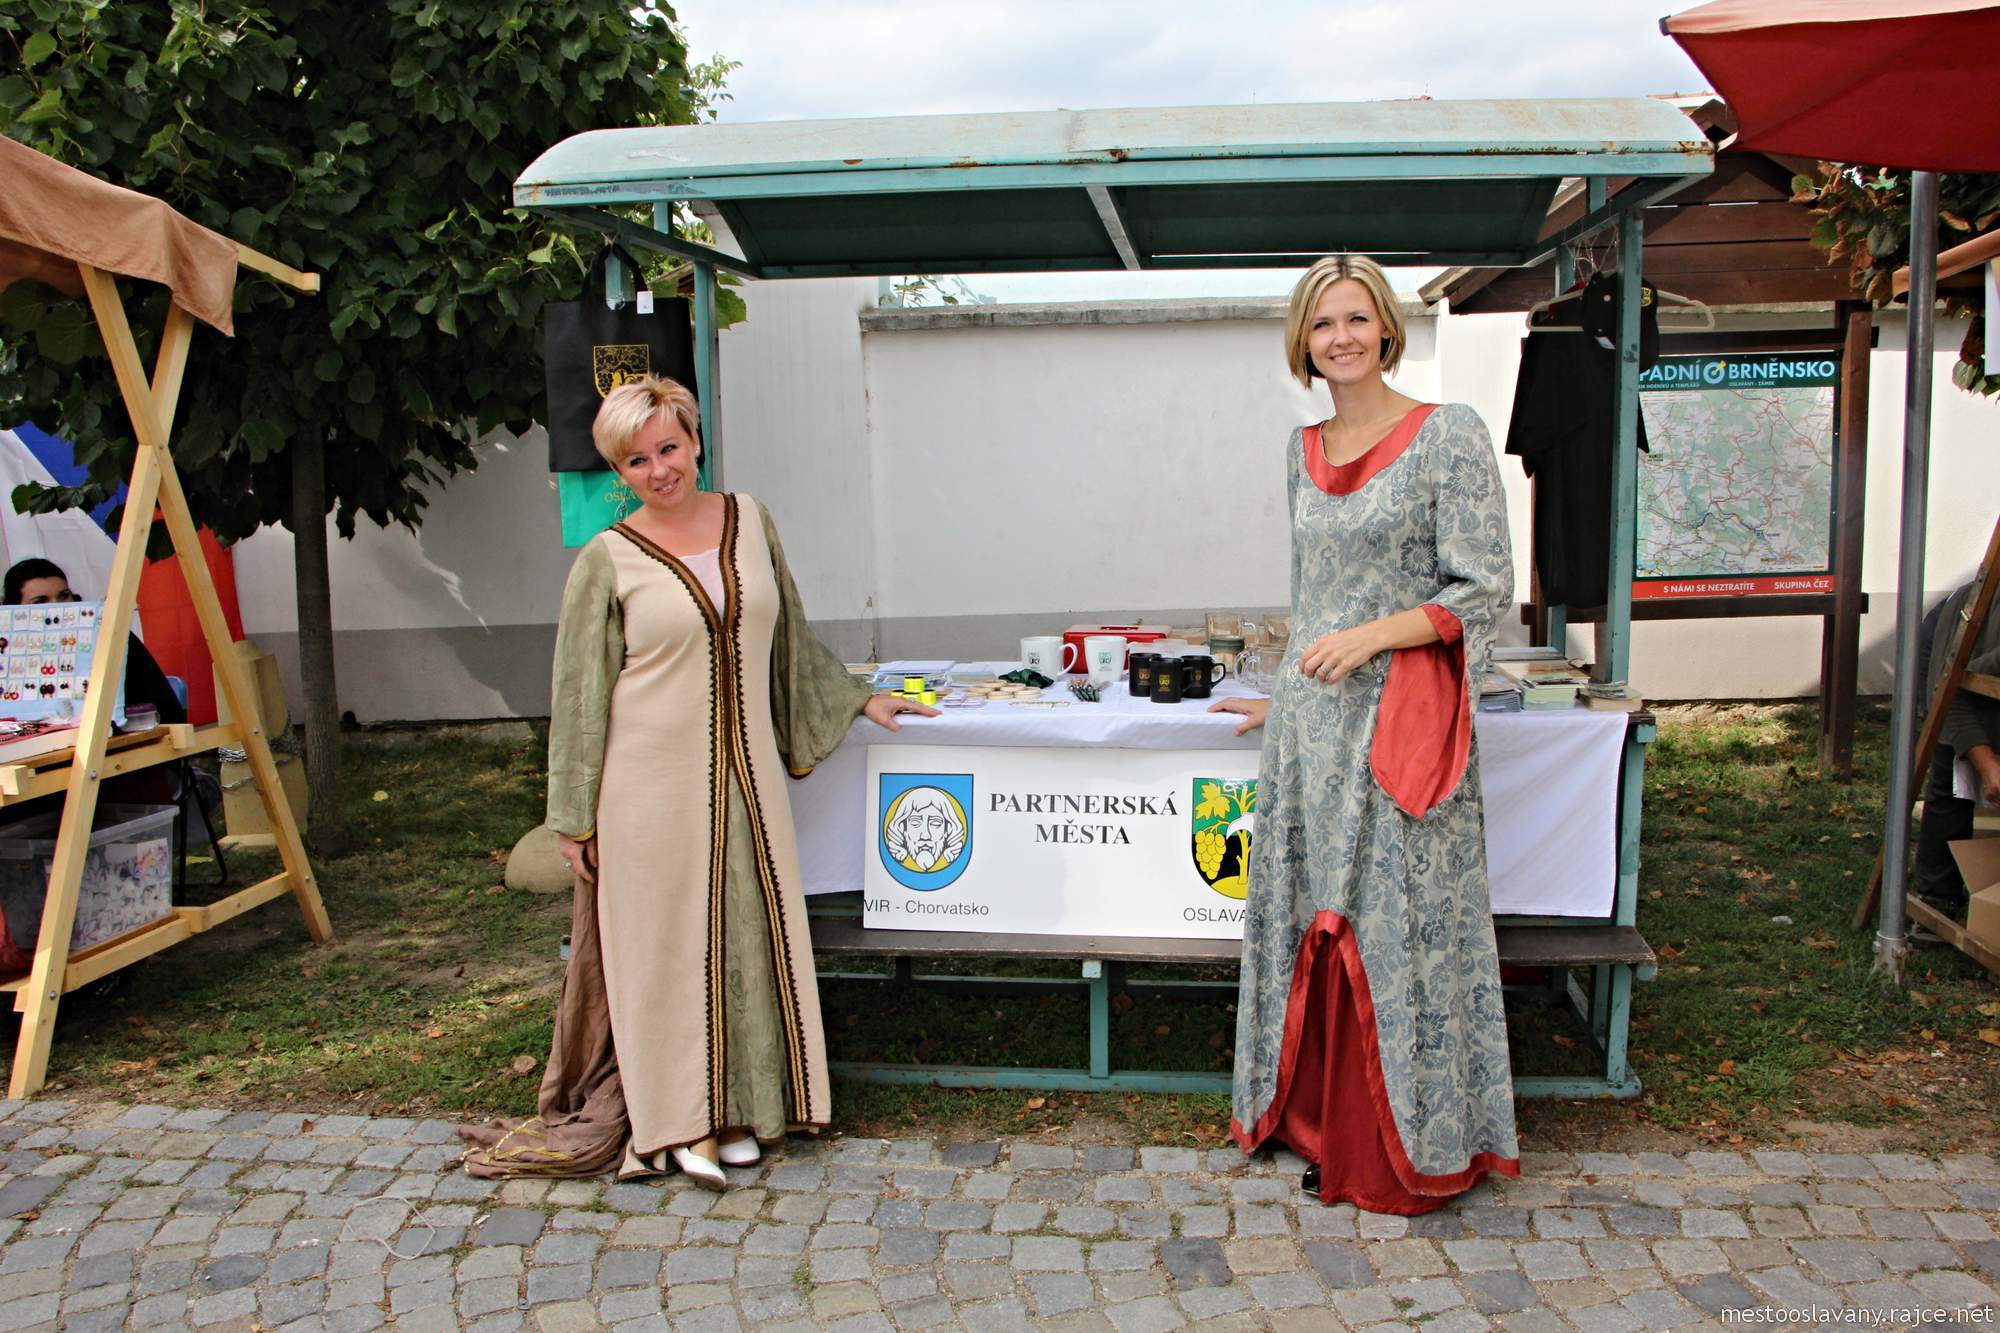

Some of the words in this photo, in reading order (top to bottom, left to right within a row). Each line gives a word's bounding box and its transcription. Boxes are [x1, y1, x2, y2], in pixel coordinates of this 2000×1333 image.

[1728, 358, 1835, 379] BRNĚNSKO
[1663, 585, 1669, 593] S
[1670, 583, 1694, 593] NÁMI
[1696, 584, 1706, 592] SE
[1707, 581, 1755, 592] NEZTRATÍTE
[1775, 581, 1812, 590] SKUPINA
[1813, 579, 1830, 588] ČEZ
[989, 790, 1178, 816] PARTNERSKÁ
[1035, 818, 1131, 845] MĚSTA
[864, 899, 890, 912] VIR
[905, 899, 989, 915] Chorvatsko
